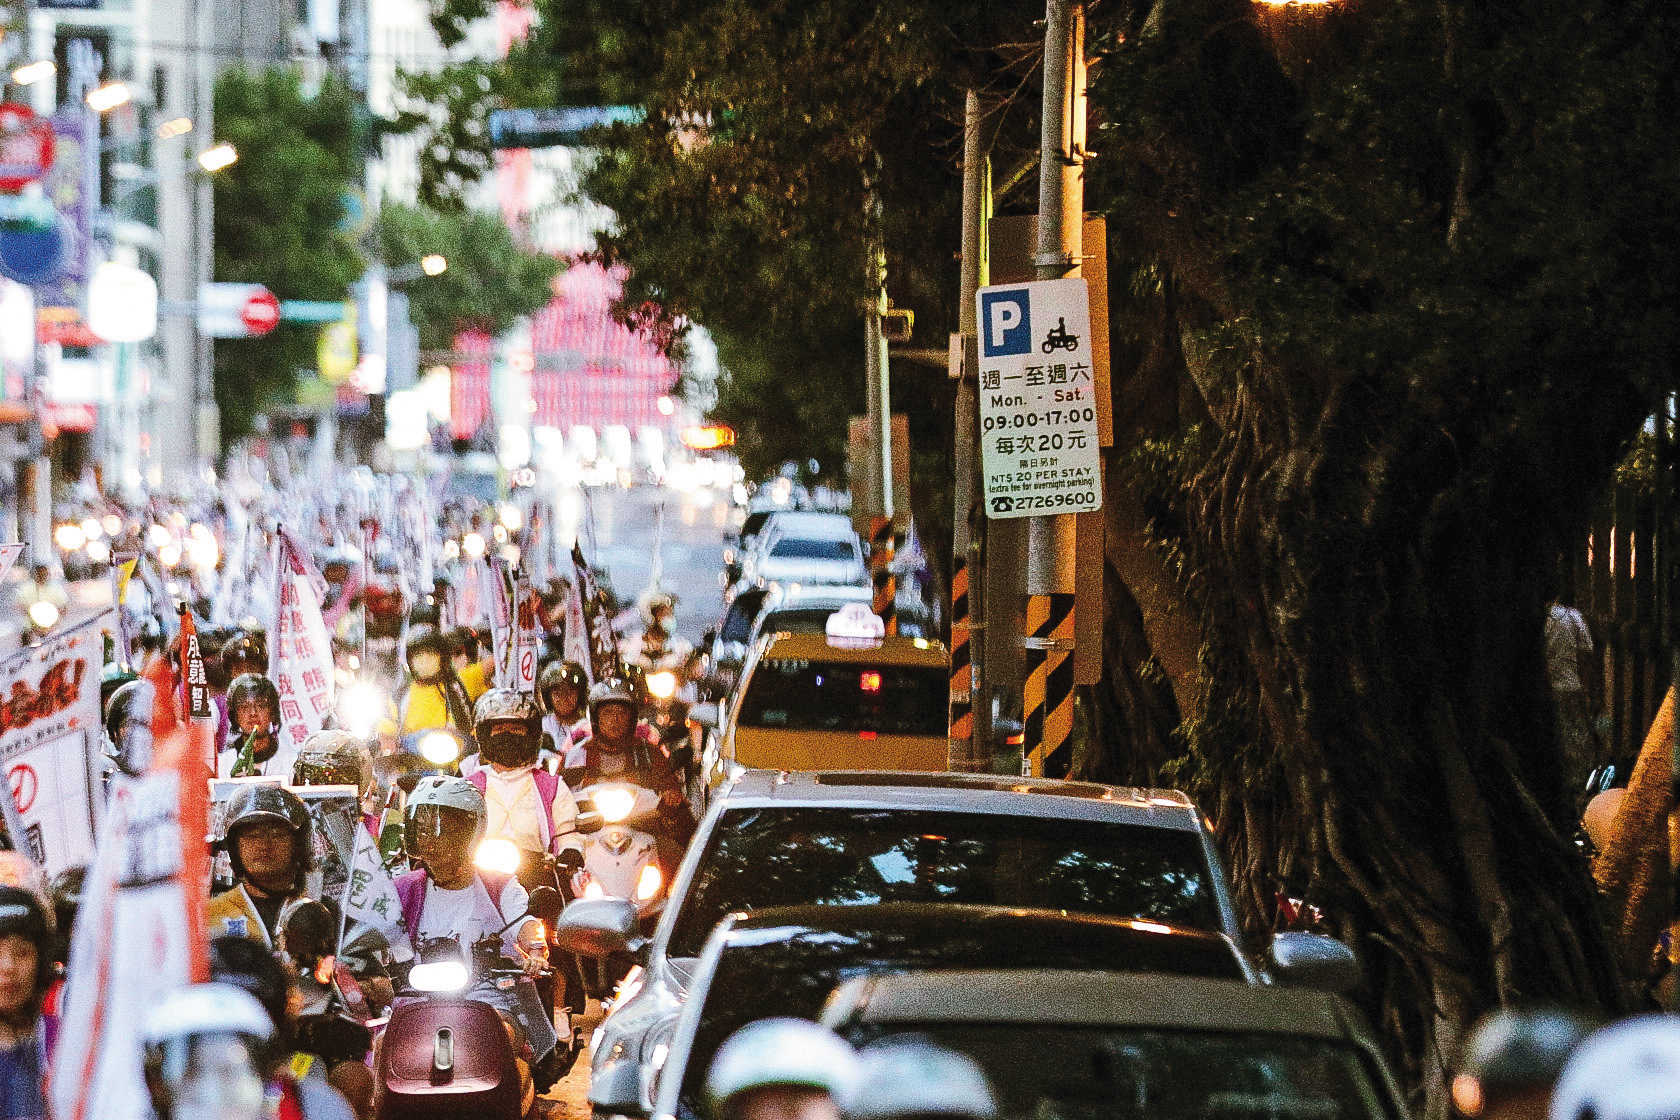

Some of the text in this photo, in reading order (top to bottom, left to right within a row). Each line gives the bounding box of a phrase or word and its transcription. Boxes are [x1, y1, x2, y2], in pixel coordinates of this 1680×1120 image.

[991, 301, 1022, 347] P
[982, 362, 1090, 390] 週一至週六
[991, 395, 1027, 408] Mon.
[1054, 388, 1085, 402] Sat.
[983, 408, 1094, 429] 09:00-17:00
[995, 430, 1087, 455] 每次20元
[1016, 471, 1032, 482] 20
[1036, 470, 1058, 480] PER
[1062, 467, 1092, 478] STAY
[1015, 492, 1096, 509] 27269600
